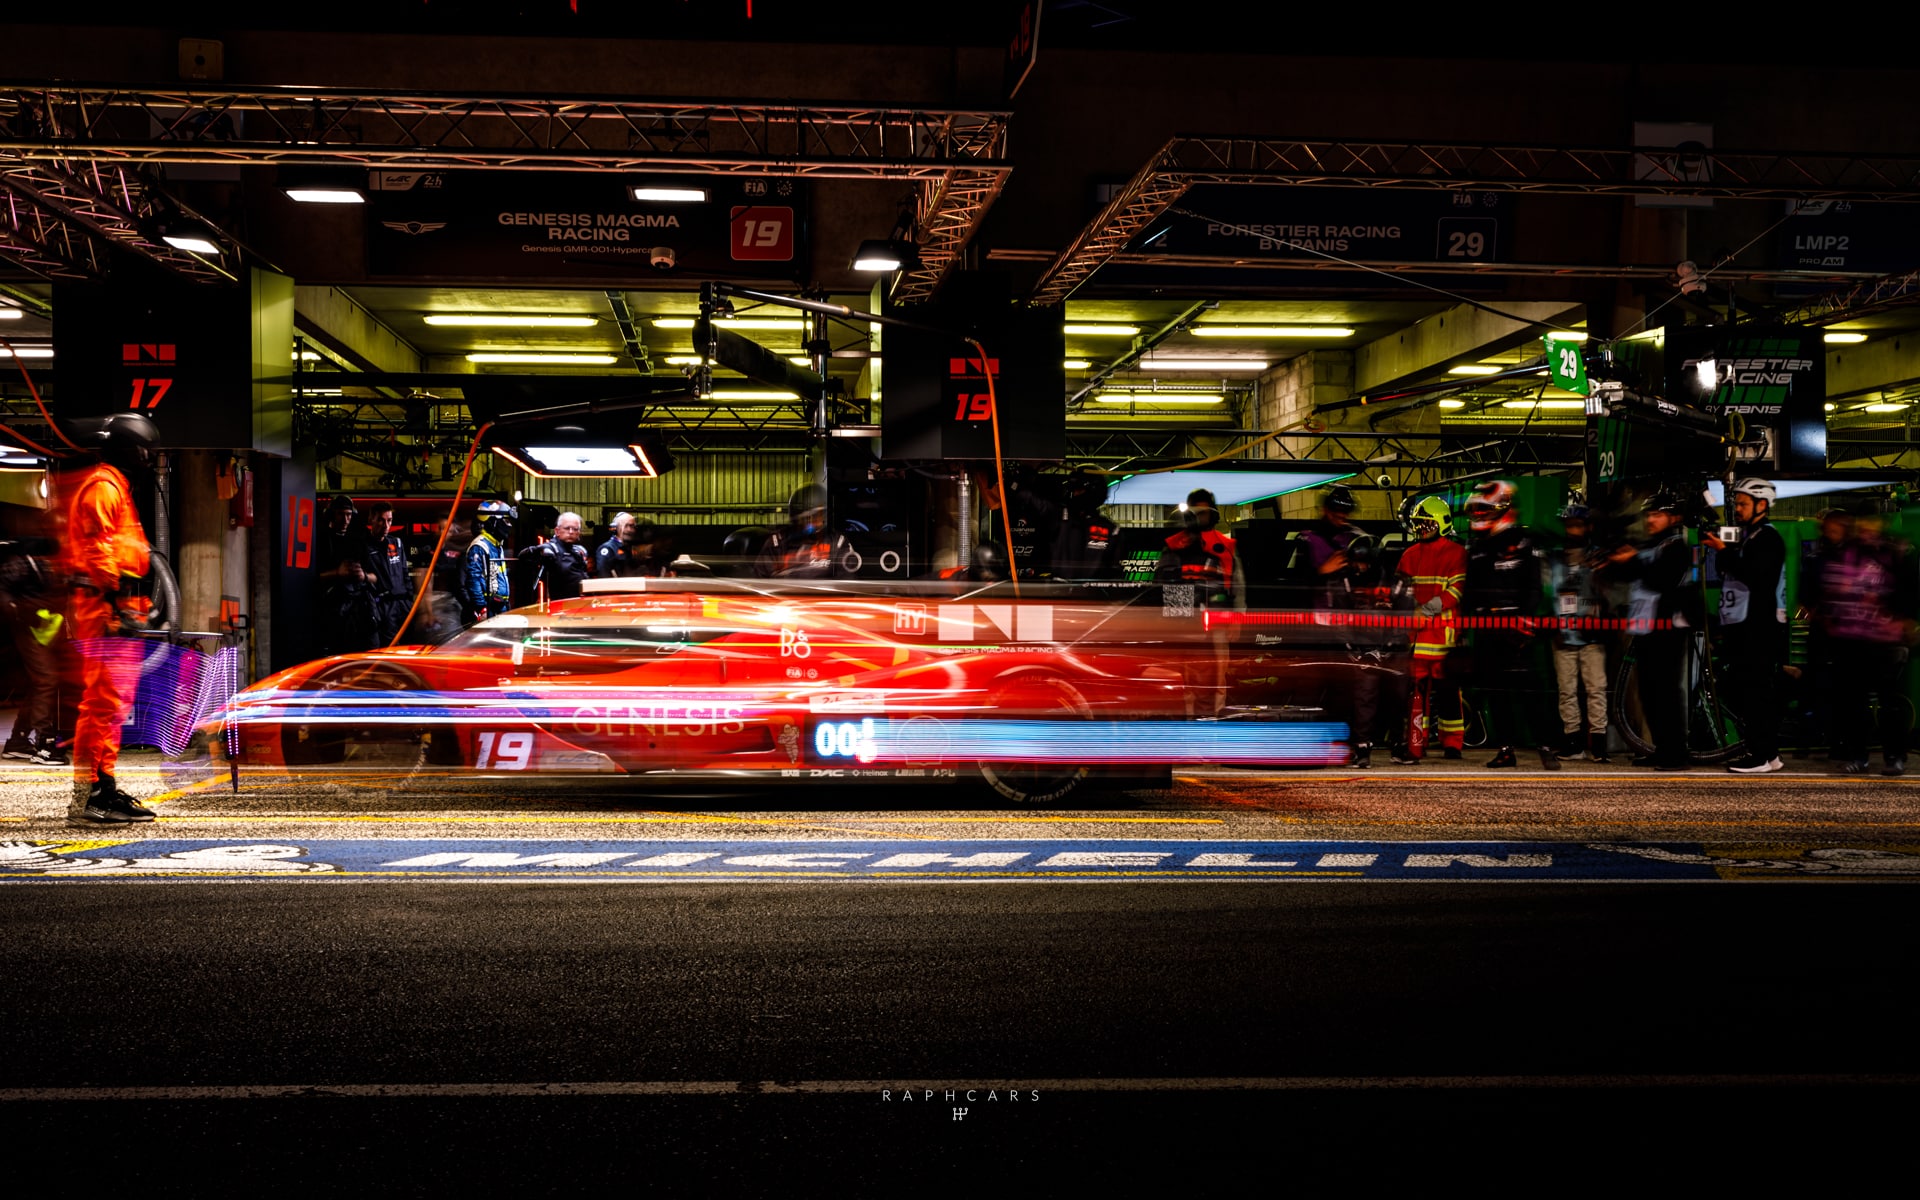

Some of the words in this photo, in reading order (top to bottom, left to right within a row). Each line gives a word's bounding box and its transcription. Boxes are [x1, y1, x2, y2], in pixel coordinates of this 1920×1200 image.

[744, 181, 767, 194] FIA
[498, 212, 592, 226] GENESIS
[597, 214, 680, 228] MAGMA
[548, 228, 630, 241] RACING
[742, 220, 783, 247] 19
[1207, 223, 1320, 238] FORESTIER
[1324, 225, 1401, 239] RACING
[521, 244, 562, 254] Genesis
[1258, 238, 1284, 251] BY
[1288, 238, 1350, 252] PANIS
[1448, 231, 1485, 257] 29
[1795, 235, 1850, 250] LMP2
[1559, 347, 1578, 380] 29
[1681, 358, 1813, 371] FRESTIER
[129, 378, 174, 408] 17
[954, 393, 993, 420] 19
[1600, 450, 1615, 477] 29
[286, 496, 314, 569] 19
[571, 705, 745, 737] GENESIS
[475, 731, 535, 771] 19
[379, 851, 1553, 868] MICHELIN
